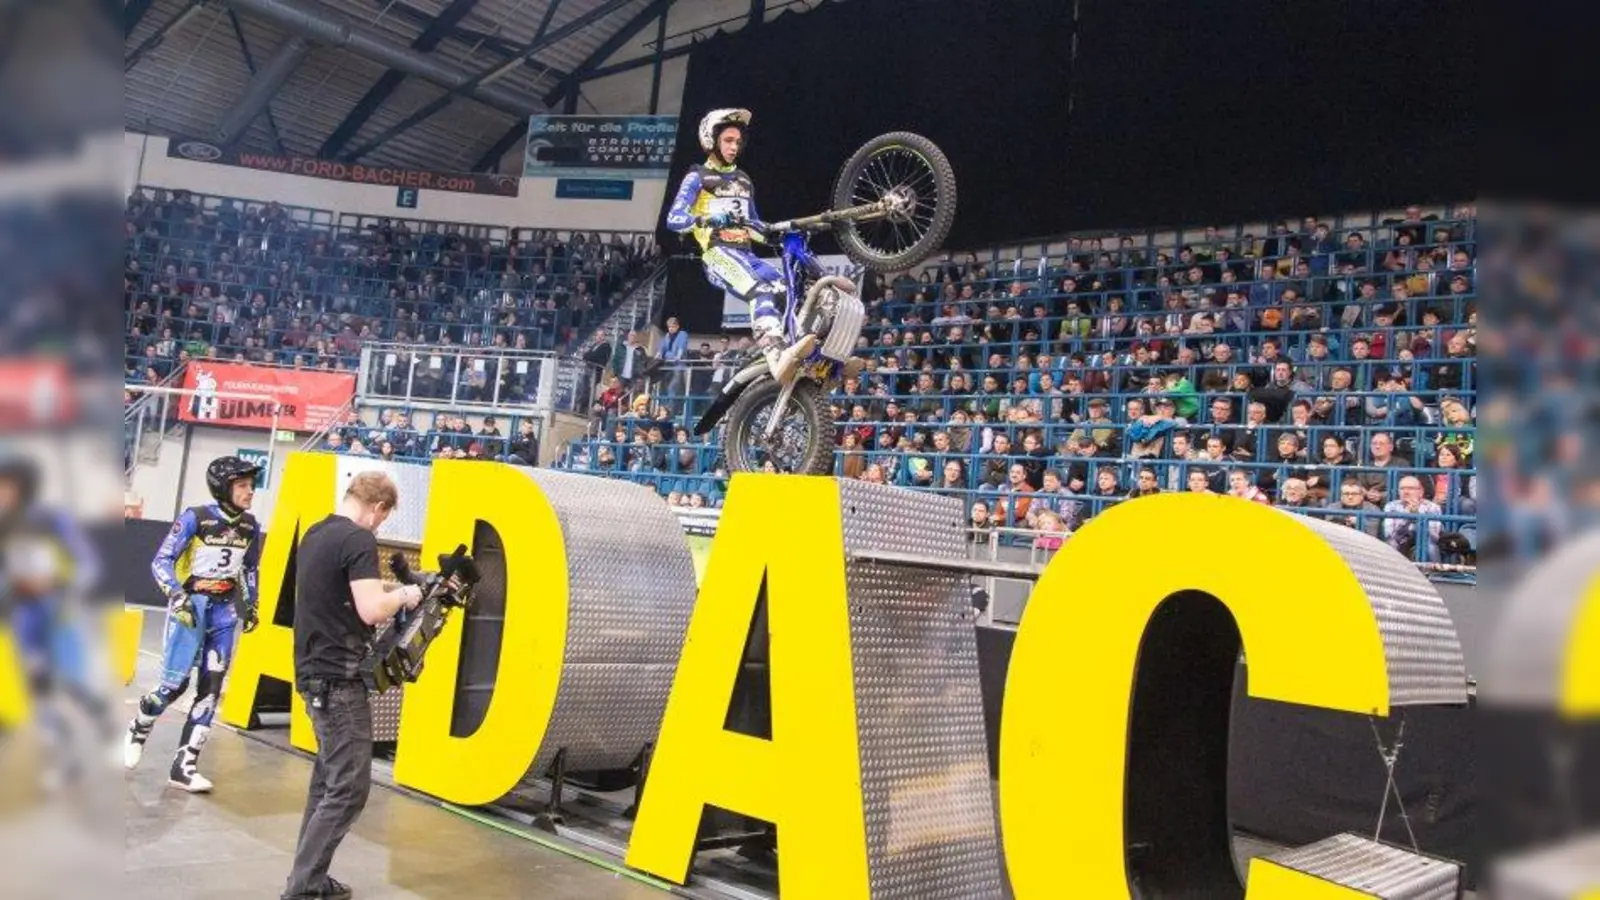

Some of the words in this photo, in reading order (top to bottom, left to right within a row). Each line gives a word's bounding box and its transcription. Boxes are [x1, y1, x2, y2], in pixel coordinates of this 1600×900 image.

[600, 122, 623, 132] die
[239, 153, 476, 190] www.FORD-BACHER.com
[402, 190, 413, 206] E
[217, 548, 232, 568] 3
[221, 451, 1391, 900] ADAC
